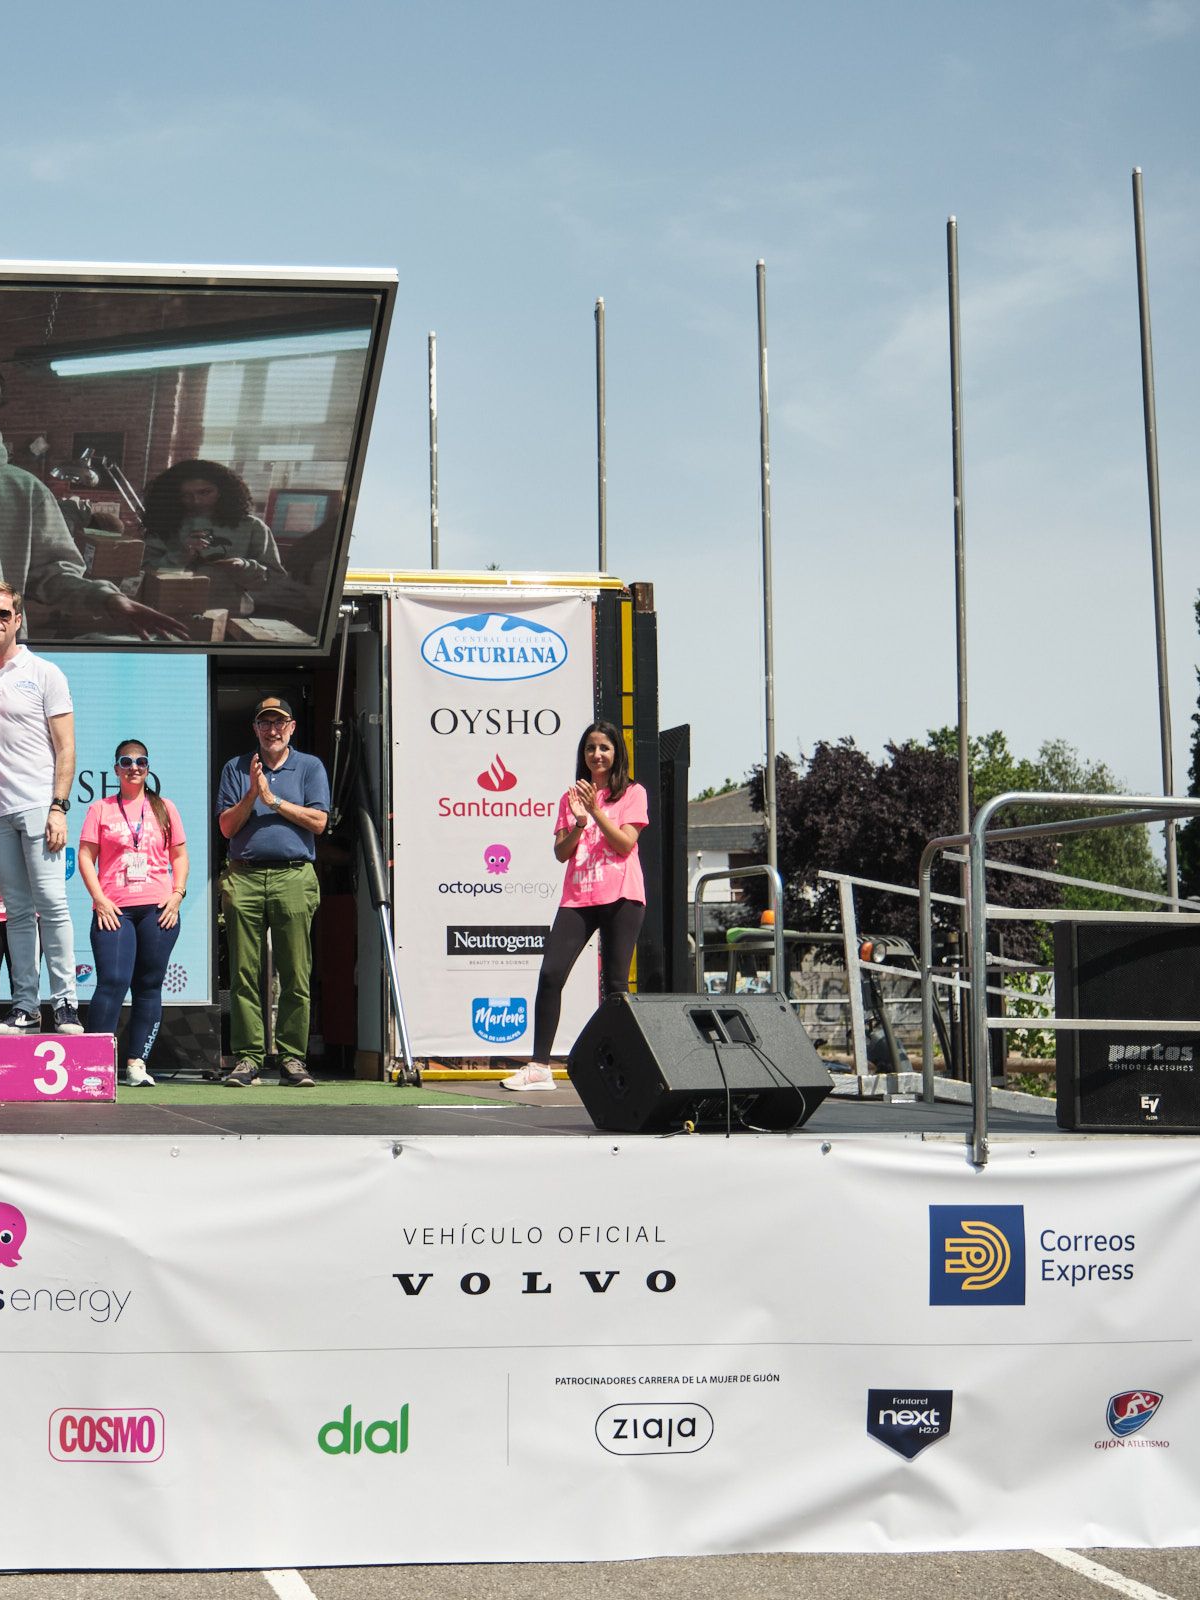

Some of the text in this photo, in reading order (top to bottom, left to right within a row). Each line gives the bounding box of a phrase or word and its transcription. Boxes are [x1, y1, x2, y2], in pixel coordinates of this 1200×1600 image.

[433, 637, 558, 663] ASTURIANA
[454, 635, 500, 643] CENTRAL
[430, 708, 561, 736] OYSHO
[438, 797, 555, 817] Santander
[438, 881, 558, 899] octopus energy
[33, 1040, 69, 1095] 3
[1141, 1096, 1160, 1113] EV
[402, 1223, 666, 1245] VEHÍCULO OFICIAL
[1039, 1229, 1136, 1252] Correos
[392, 1270, 677, 1296] VOLVO
[1041, 1259, 1135, 1287] Express
[10, 1288, 132, 1323] energy
[555, 1373, 781, 1385] PATROCINADORES CARRERA DE LA MUJER DE GIJÓN
[892, 1397, 929, 1405] Fontarel
[317, 1402, 410, 1456] dial
[878, 1408, 940, 1427] next
[59, 1414, 156, 1454] COSMO
[612, 1416, 698, 1448] ziaja
[1094, 1438, 1170, 1450] GIJÓN ATLETISMO
